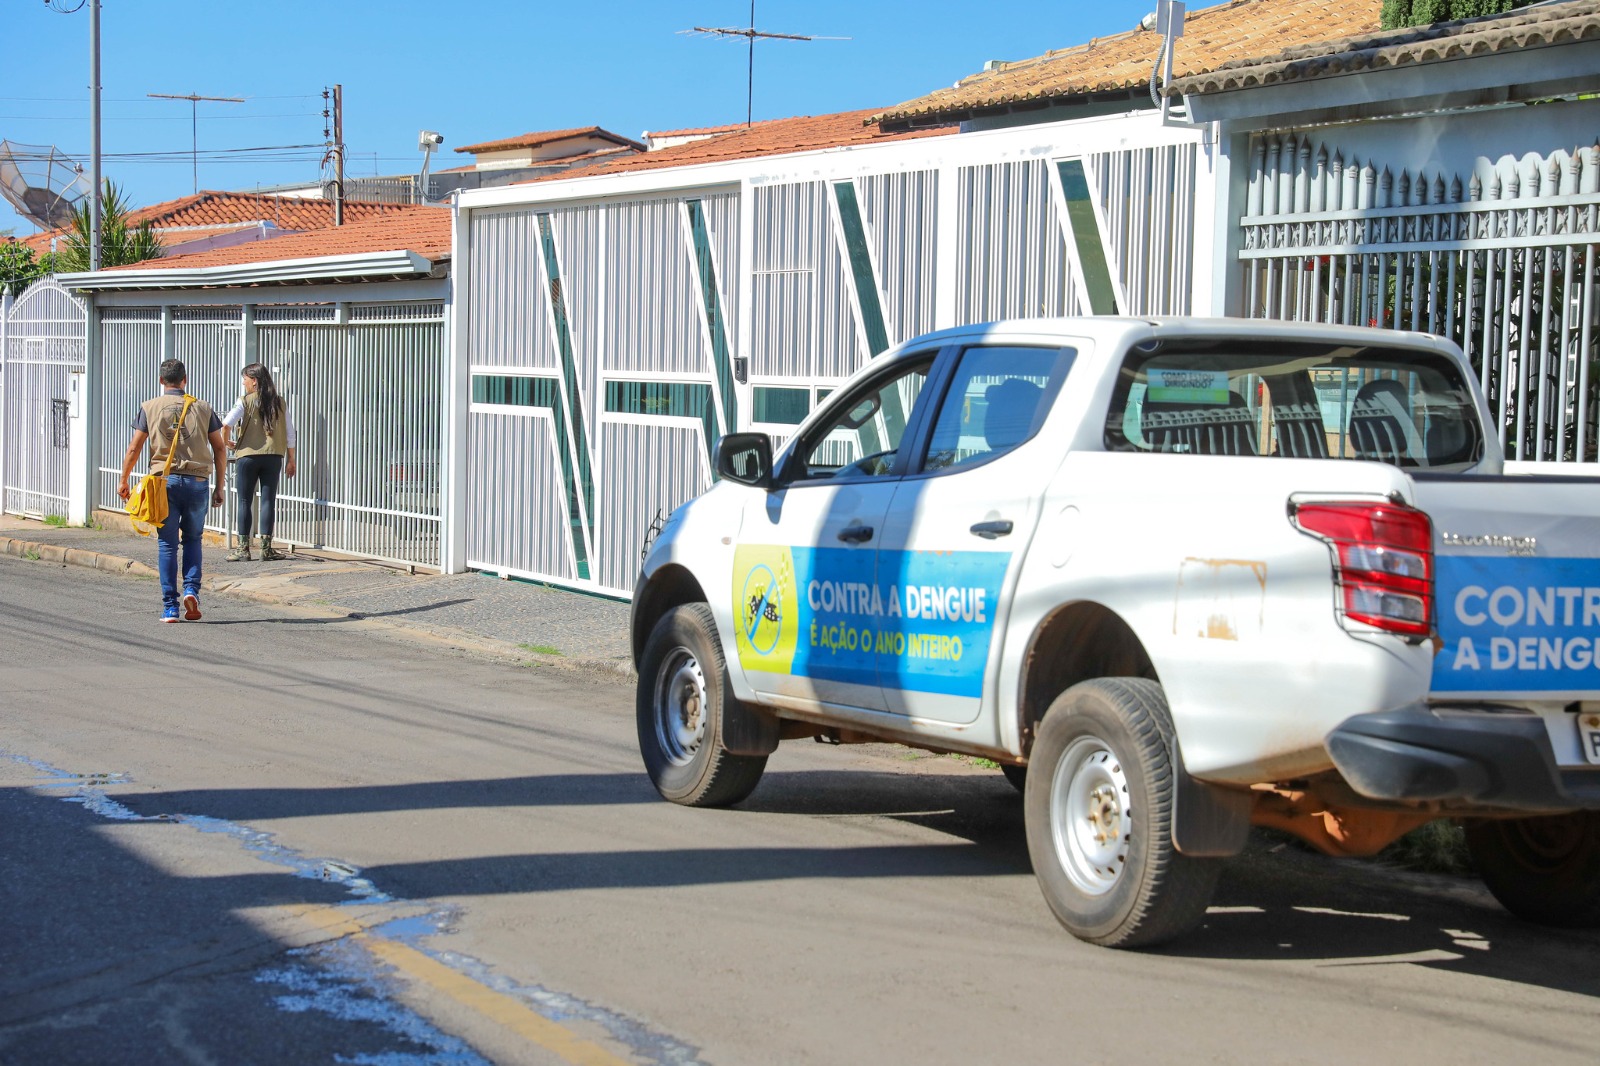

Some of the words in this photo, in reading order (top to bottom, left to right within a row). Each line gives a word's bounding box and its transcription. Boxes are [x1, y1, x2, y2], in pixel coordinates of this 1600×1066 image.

[808, 580, 883, 617] CONTRA
[888, 585, 903, 618] A
[906, 586, 986, 623] DENGUE
[810, 618, 818, 647] É
[820, 621, 858, 655] AÇÃO
[860, 629, 872, 653] O
[875, 631, 905, 656] ANO
[908, 633, 963, 661] INTEIRO
[1452, 637, 1481, 670] A
